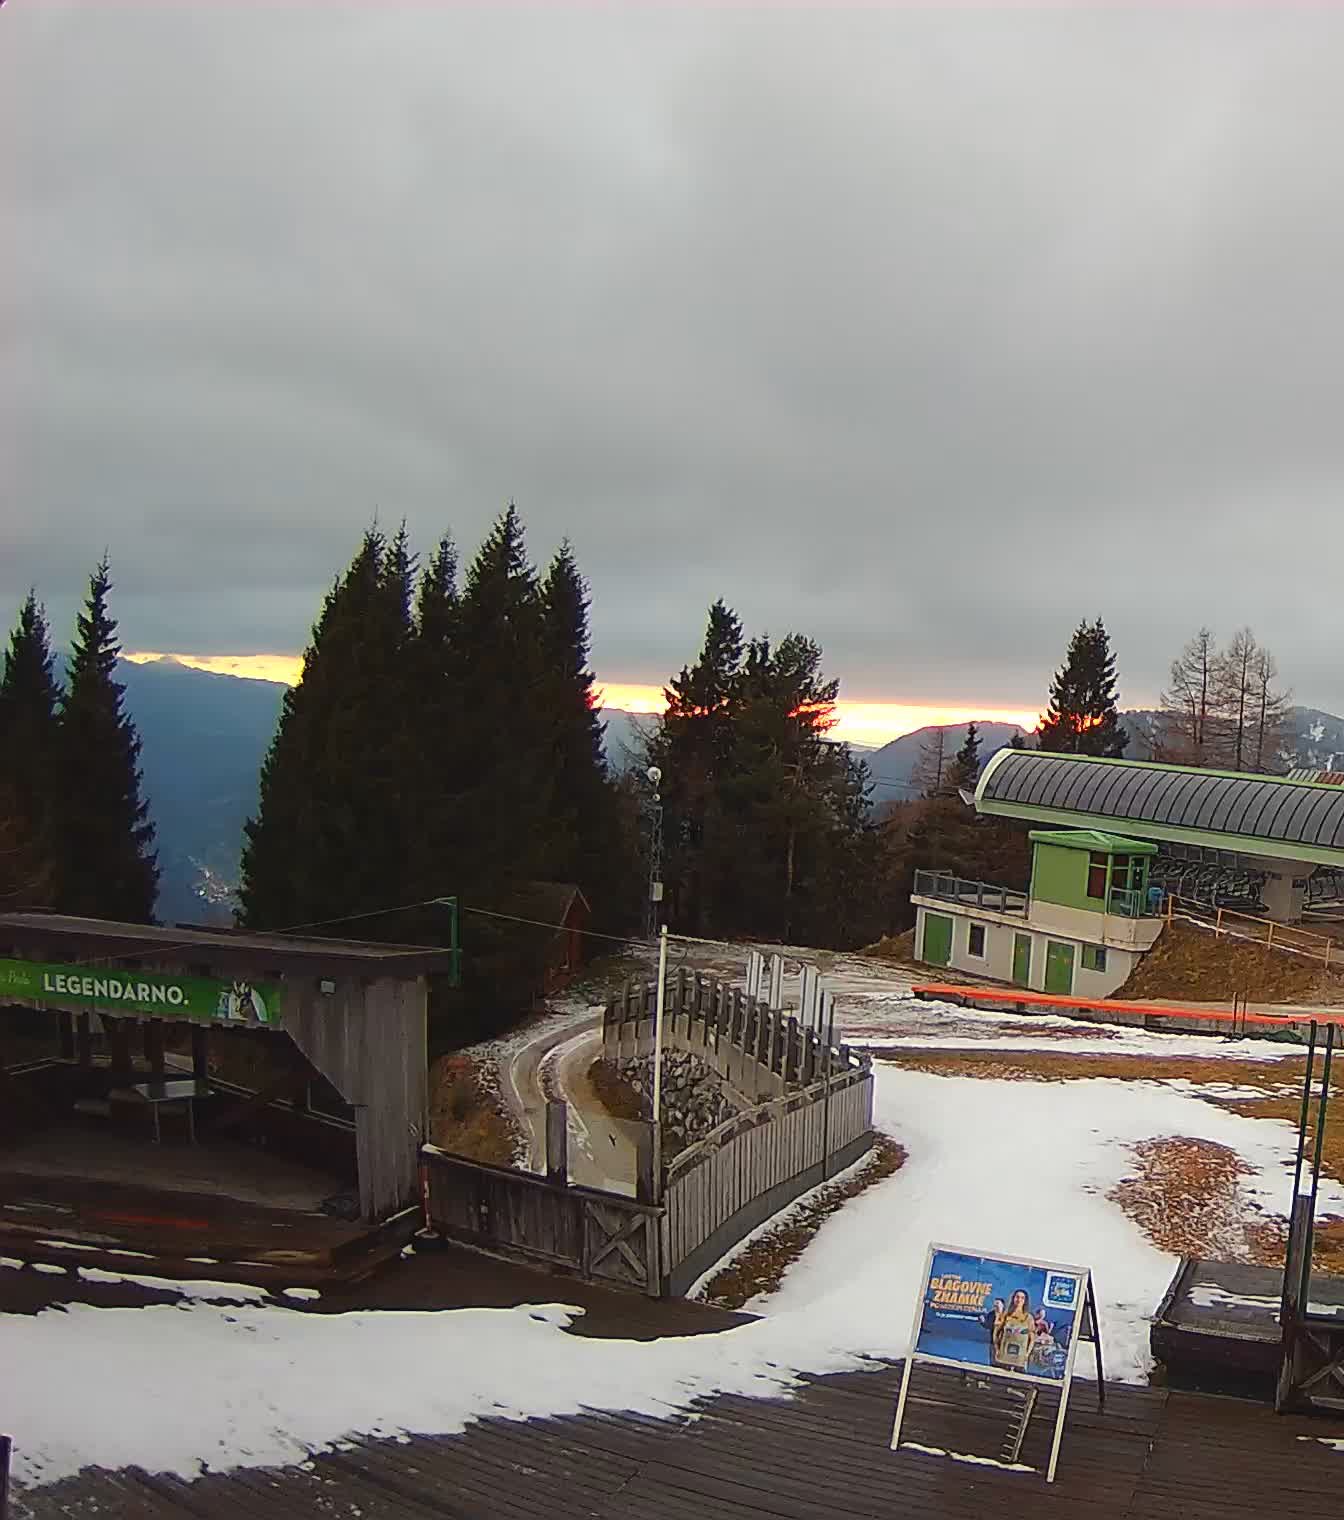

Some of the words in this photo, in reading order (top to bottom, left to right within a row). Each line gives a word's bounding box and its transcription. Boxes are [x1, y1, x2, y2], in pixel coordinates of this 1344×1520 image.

[43, 972, 190, 1005] LEGENDARNO.
[930, 1277, 993, 1297] BLAGOVNE
[932, 1290, 985, 1308] ZNAMKE
